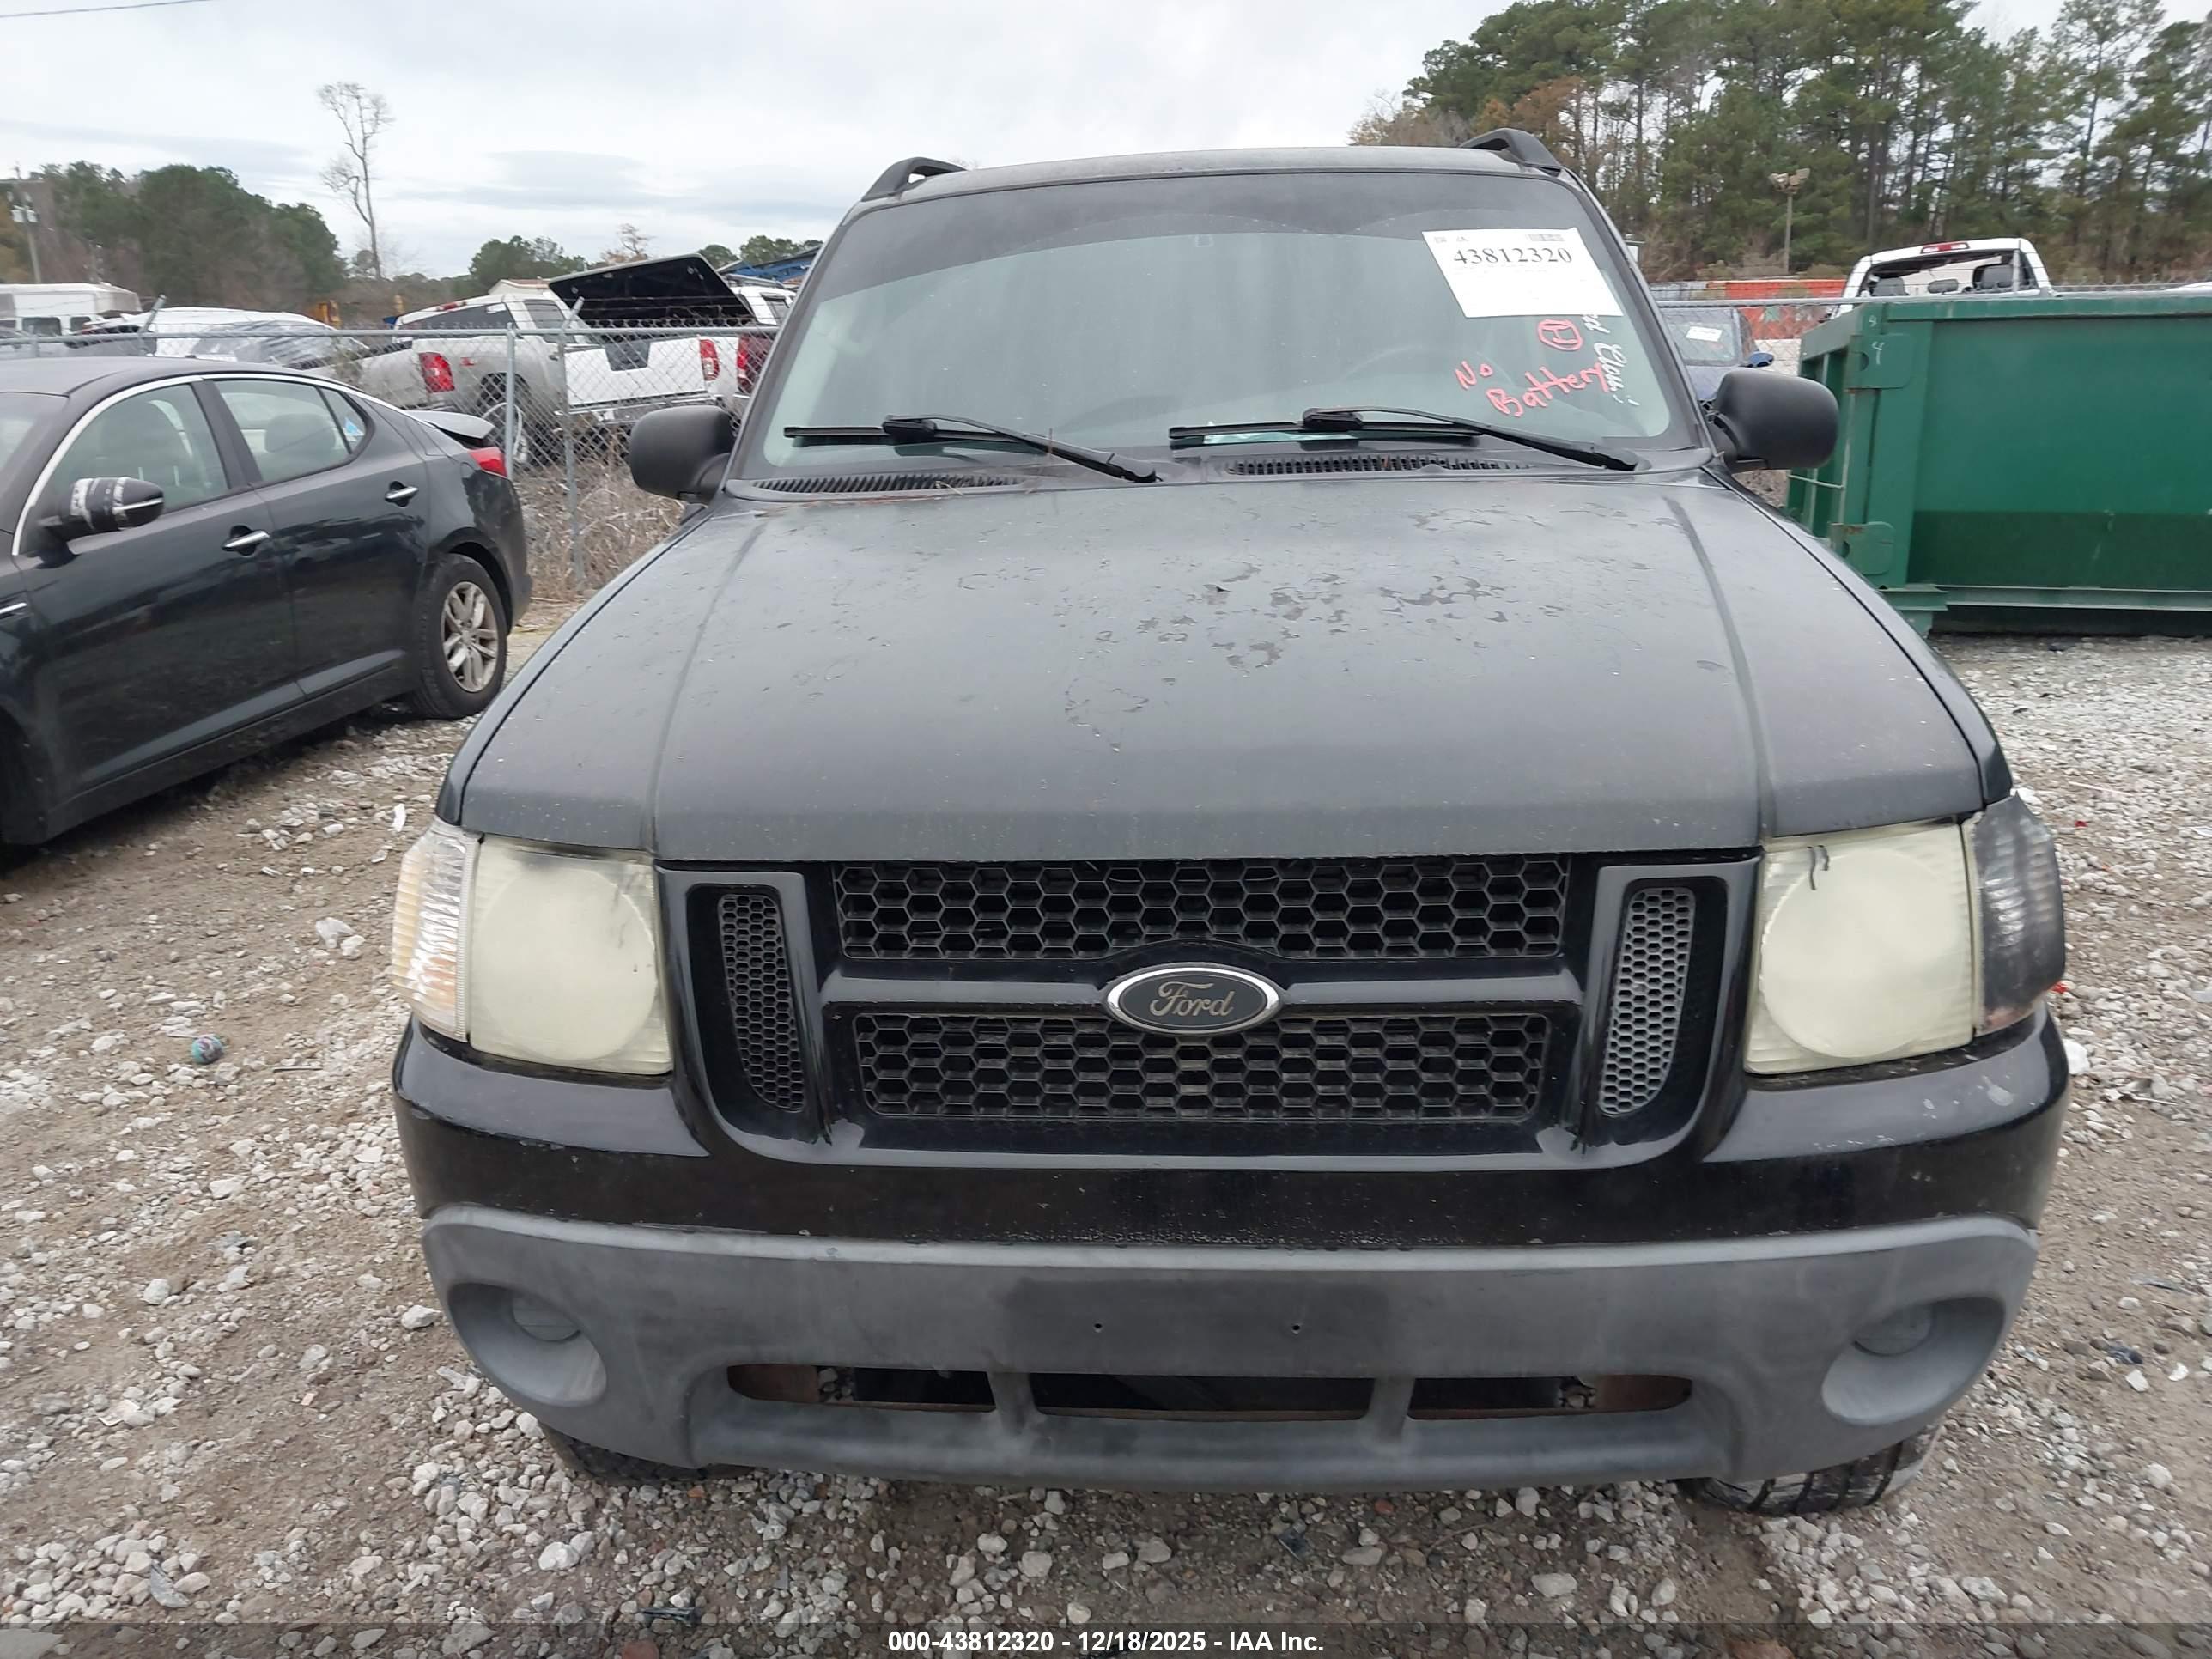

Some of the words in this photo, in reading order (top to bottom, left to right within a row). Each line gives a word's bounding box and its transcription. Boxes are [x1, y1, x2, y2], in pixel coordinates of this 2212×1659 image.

[1453, 247, 1573, 264] 43812320
[1455, 361, 1493, 390] No
[1486, 362, 1609, 417] Battery
[1149, 981, 1235, 1017] Ford
